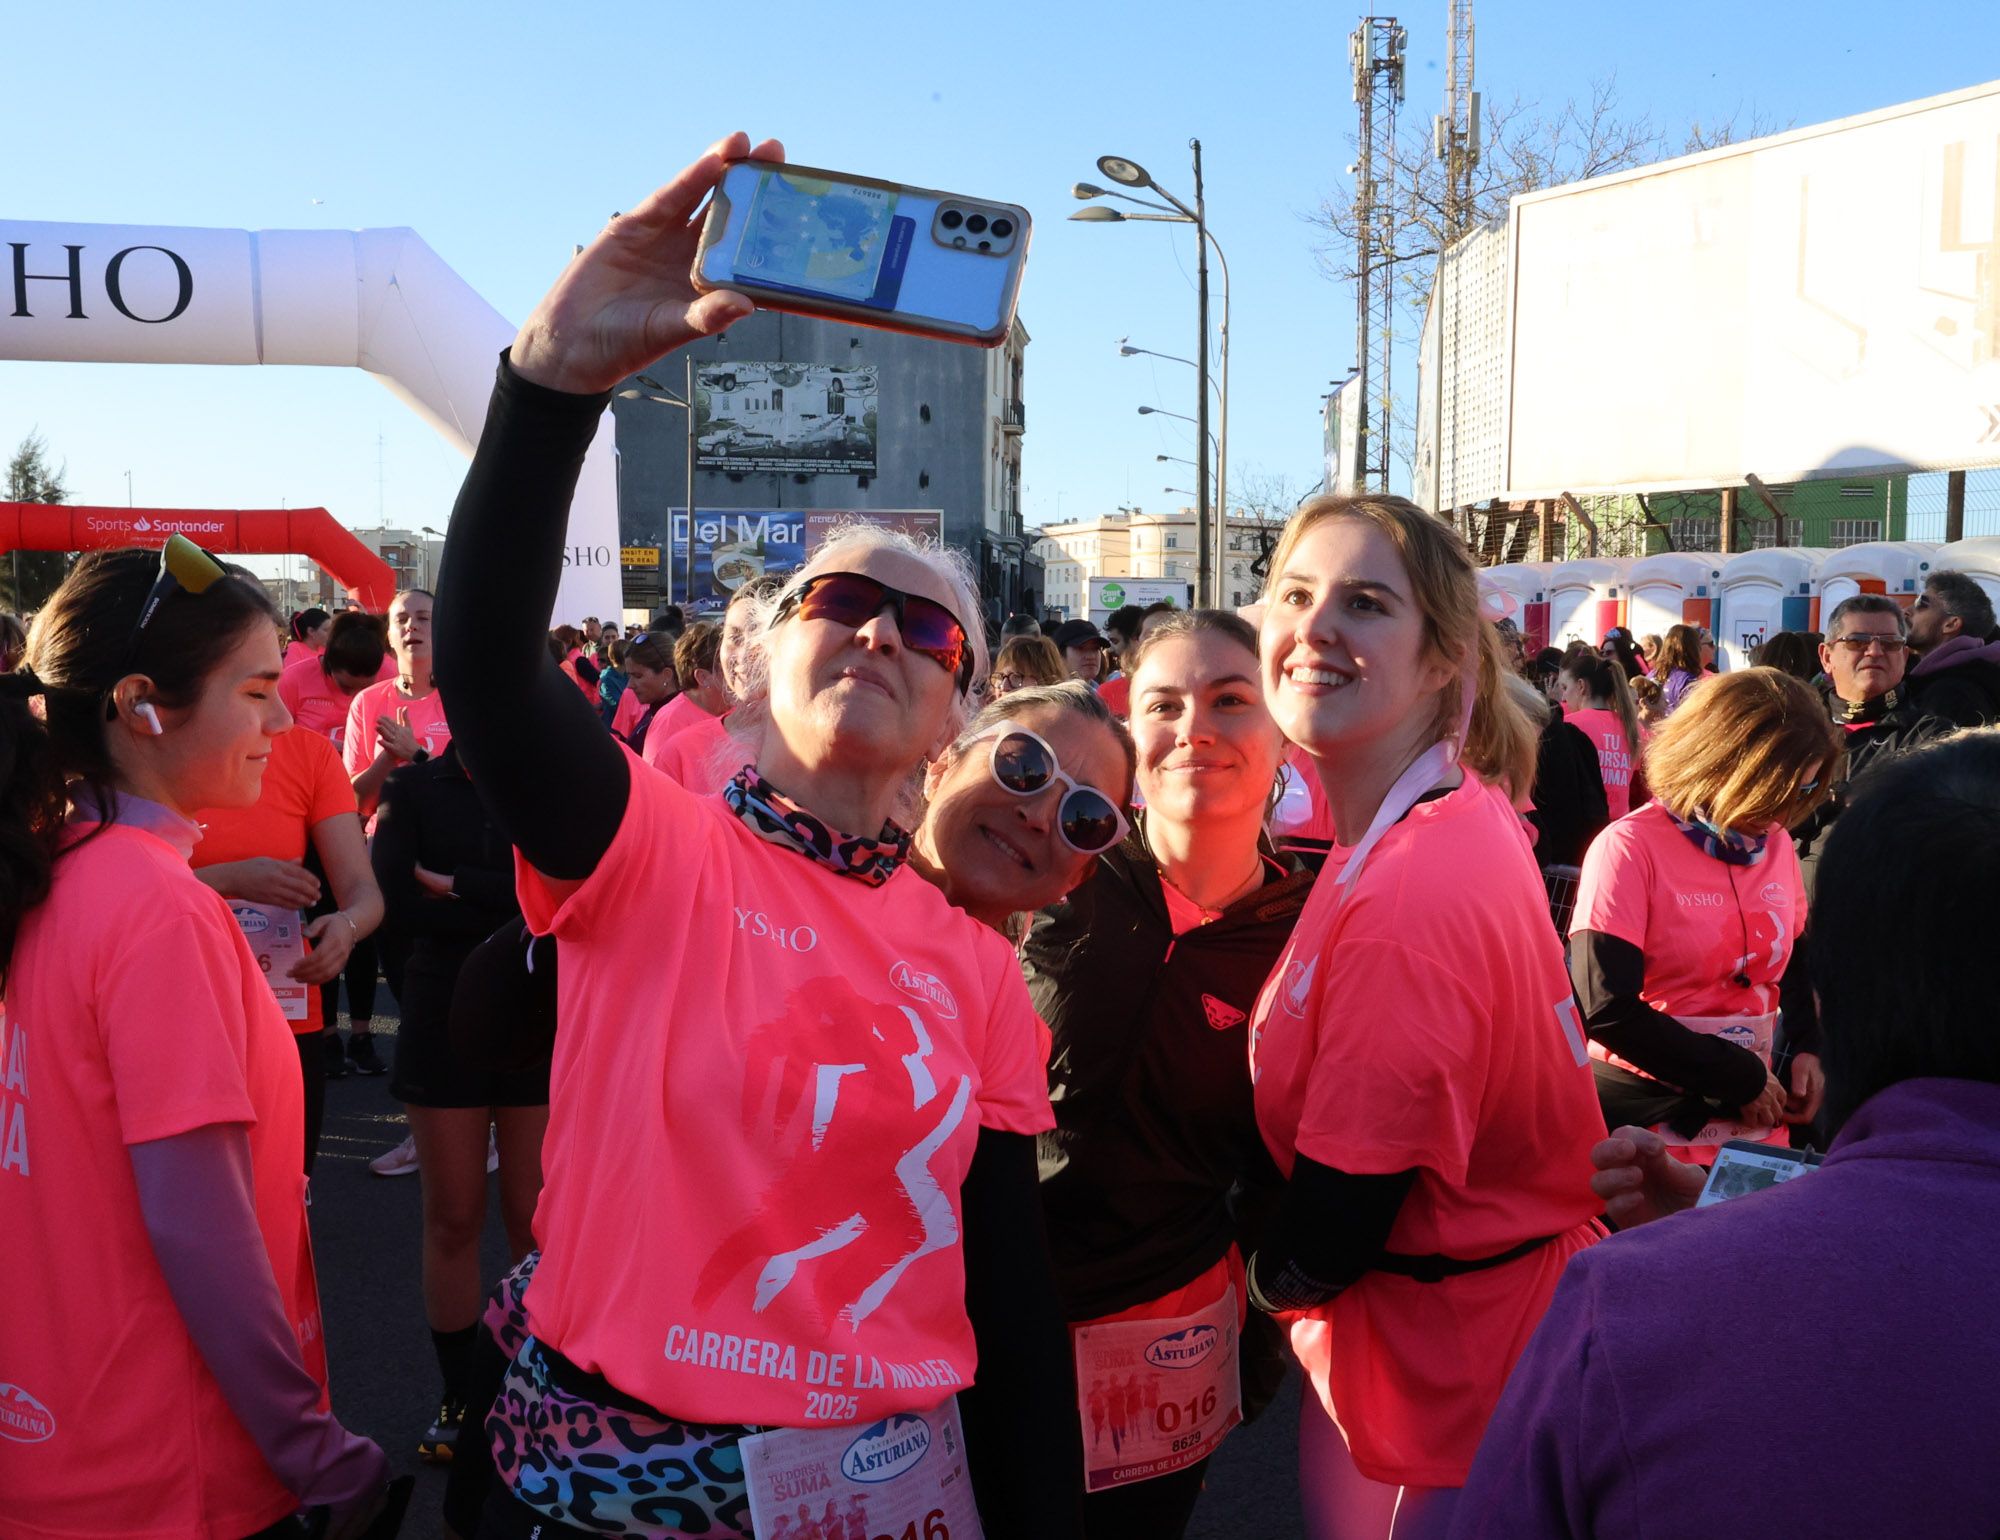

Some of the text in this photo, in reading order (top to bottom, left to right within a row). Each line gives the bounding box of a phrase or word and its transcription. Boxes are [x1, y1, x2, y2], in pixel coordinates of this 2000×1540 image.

[86, 516, 225, 533] Sports Santander
[673, 514, 804, 544] Del Mar
[1602, 732, 1620, 750] TU
[1675, 892, 1724, 907] OYSHO
[664, 1323, 963, 1390] CARRERA DE LA MUJER
[1151, 1335, 1215, 1361] ASTURIANA
[804, 1391, 859, 1421] 2025
[1156, 1385, 1217, 1433] 016
[850, 1431, 928, 1477] ASTURIANA
[1172, 1431, 1202, 1453] 8629
[768, 1461, 829, 1484] TU DORSAL
[1112, 1464, 1155, 1481] CARRERA
[1157, 1461, 1169, 1471] DE
[1171, 1456, 1182, 1467] LA
[773, 1472, 832, 1502] SUMA
[871, 1508, 950, 1540] 16
